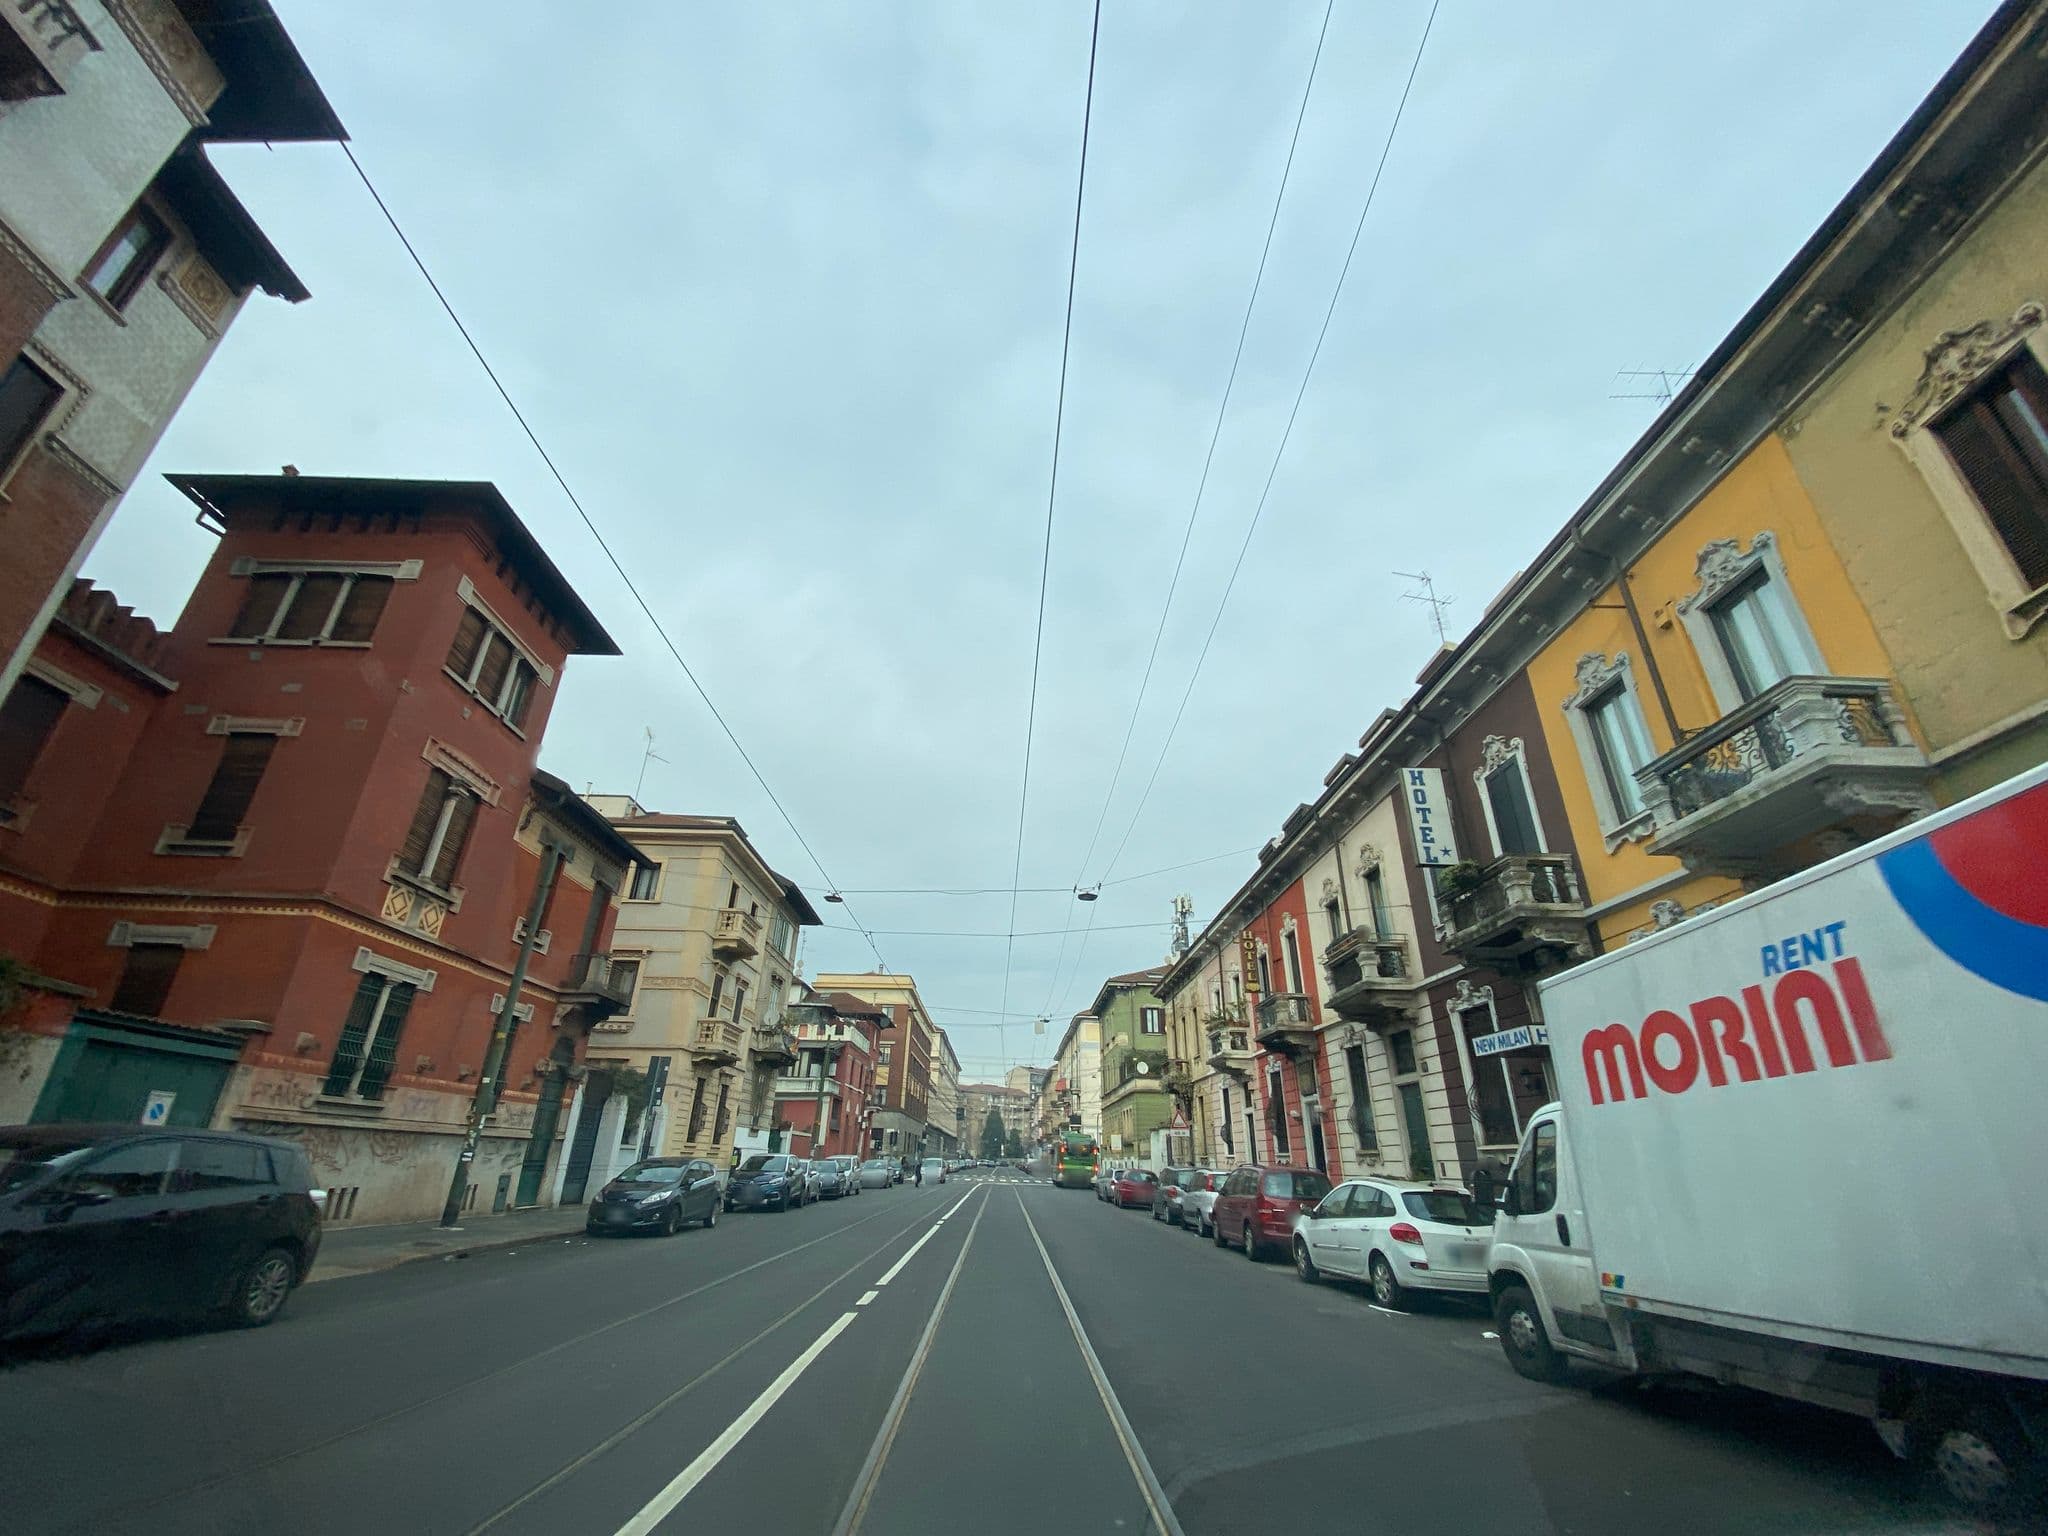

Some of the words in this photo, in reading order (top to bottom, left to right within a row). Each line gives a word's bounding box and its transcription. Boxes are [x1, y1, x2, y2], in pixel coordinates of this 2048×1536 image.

[1409, 770, 1440, 864] HOTEL
[1242, 930, 1258, 981] HOTEL
[1760, 920, 1847, 976] RENT
[1475, 1037, 1496, 1054] NEW
[1497, 1029, 1529, 1049] MILAN
